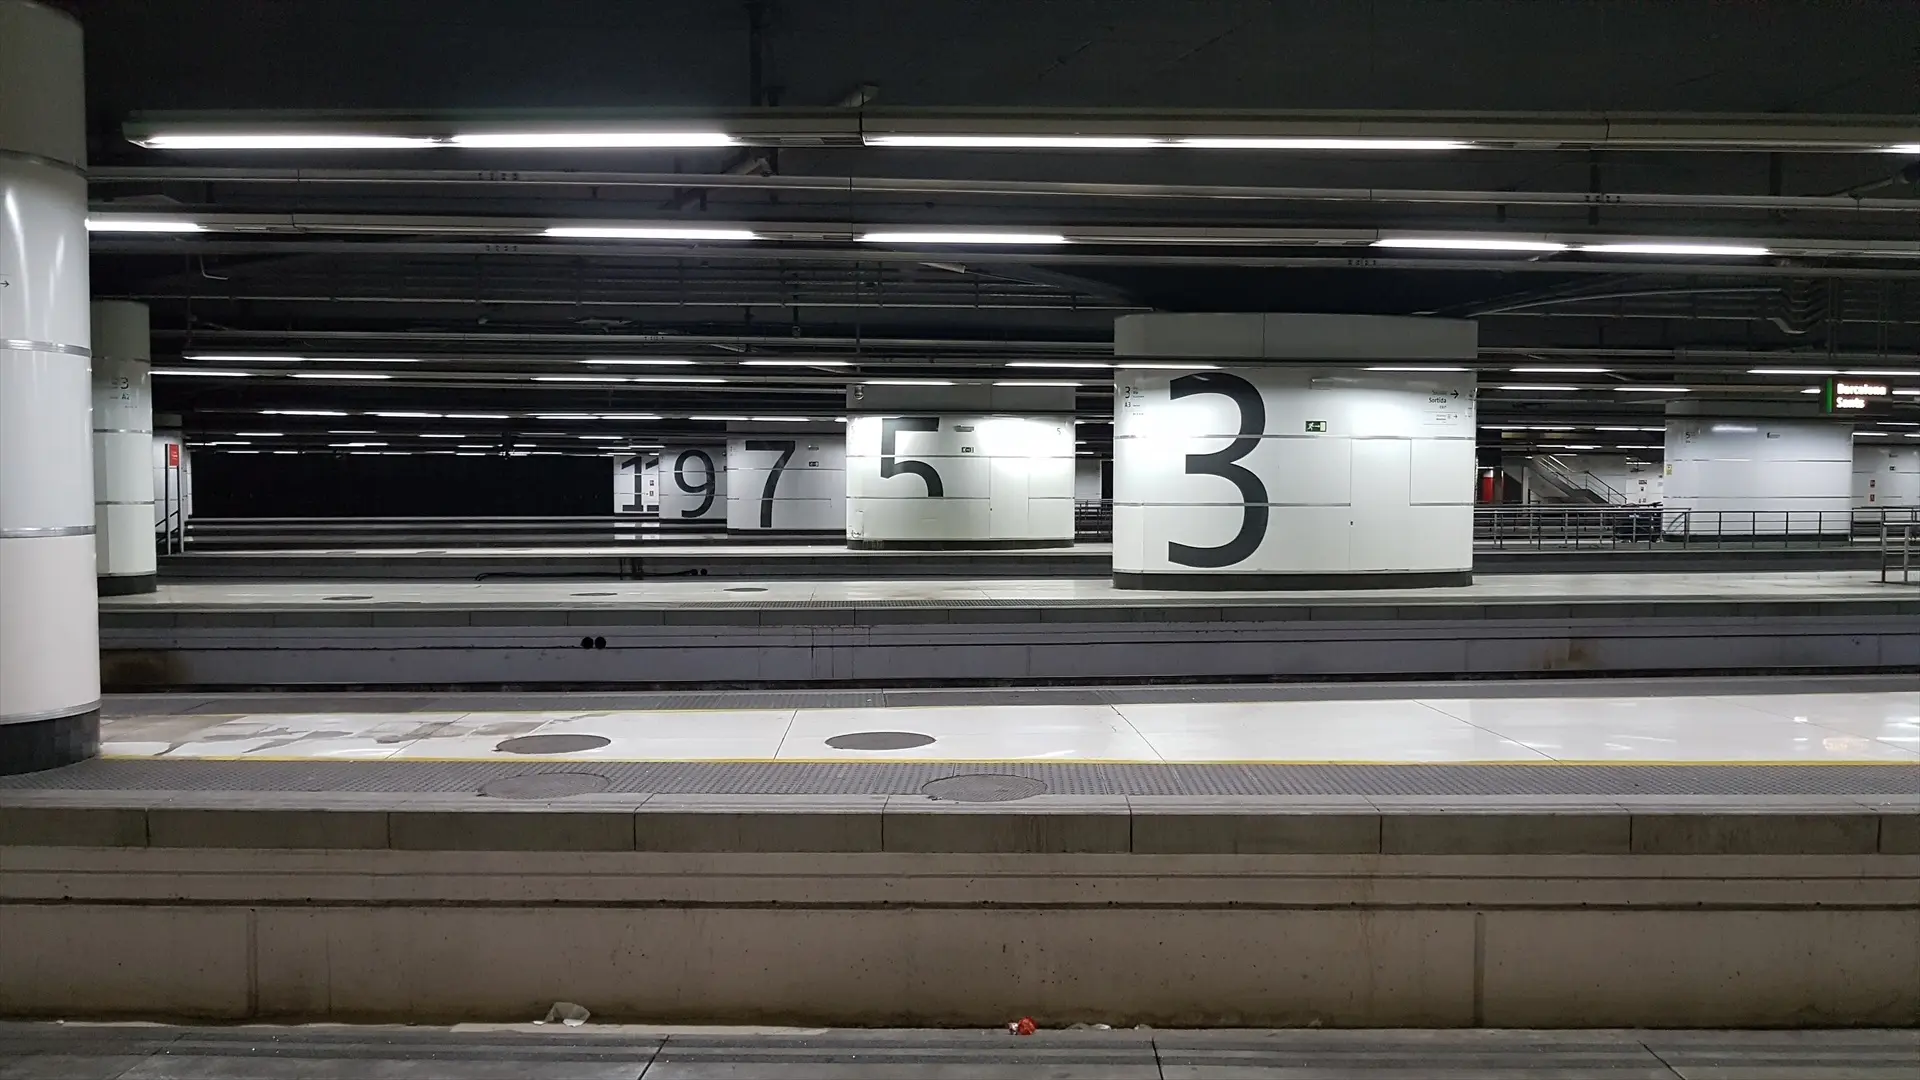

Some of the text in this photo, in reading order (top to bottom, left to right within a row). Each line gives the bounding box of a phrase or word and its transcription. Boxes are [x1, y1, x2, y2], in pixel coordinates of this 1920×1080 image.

[1125, 386, 1131, 398] 3
[673, 450, 716, 518] 9
[745, 440, 796, 528] 7
[880, 417, 944, 497] 5
[1169, 372, 1269, 568] 3
